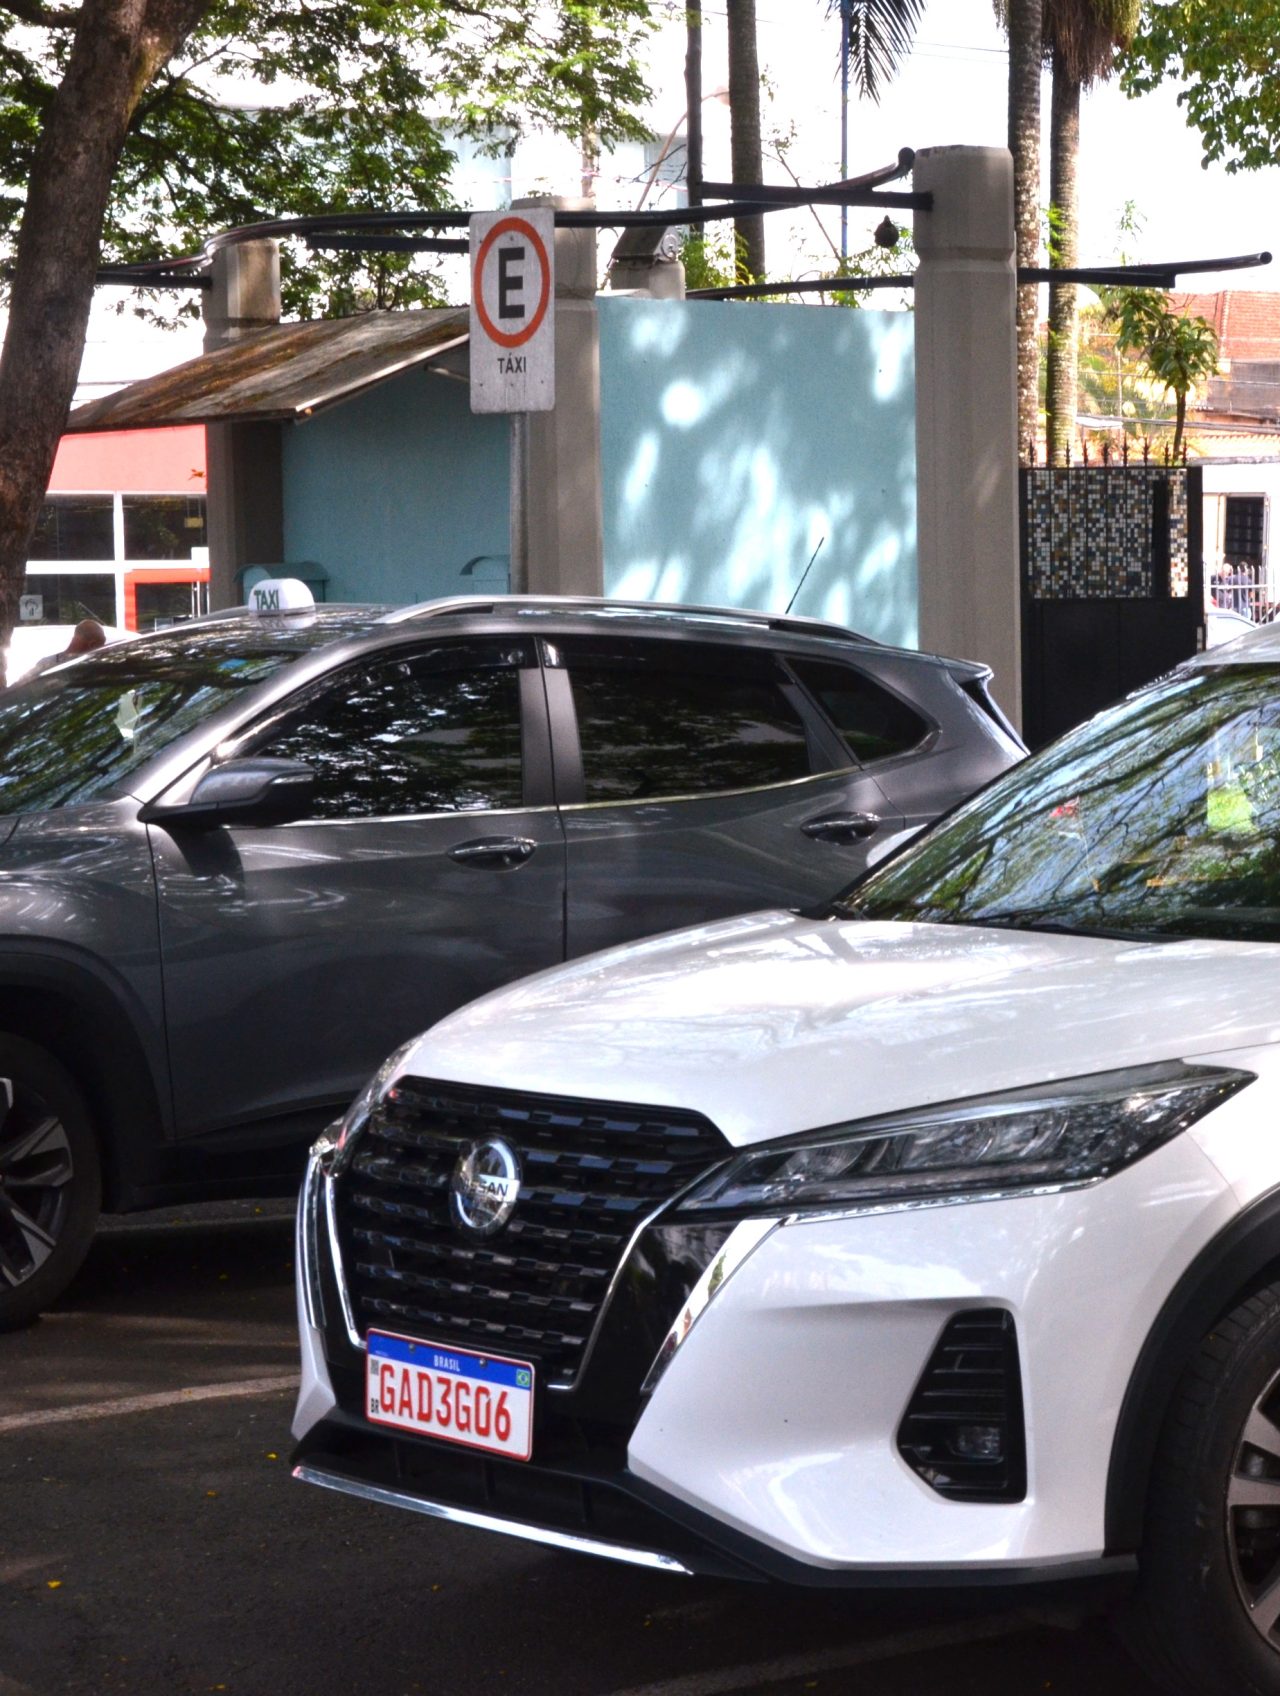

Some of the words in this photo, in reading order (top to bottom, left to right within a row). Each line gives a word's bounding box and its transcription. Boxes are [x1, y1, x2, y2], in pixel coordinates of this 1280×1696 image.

[498, 247, 525, 319] E
[497, 353, 527, 374] TÁXI
[253, 588, 280, 611] TAXI
[434, 1354, 461, 1372] BRASIL
[380, 1363, 512, 1442] GAD3G06
